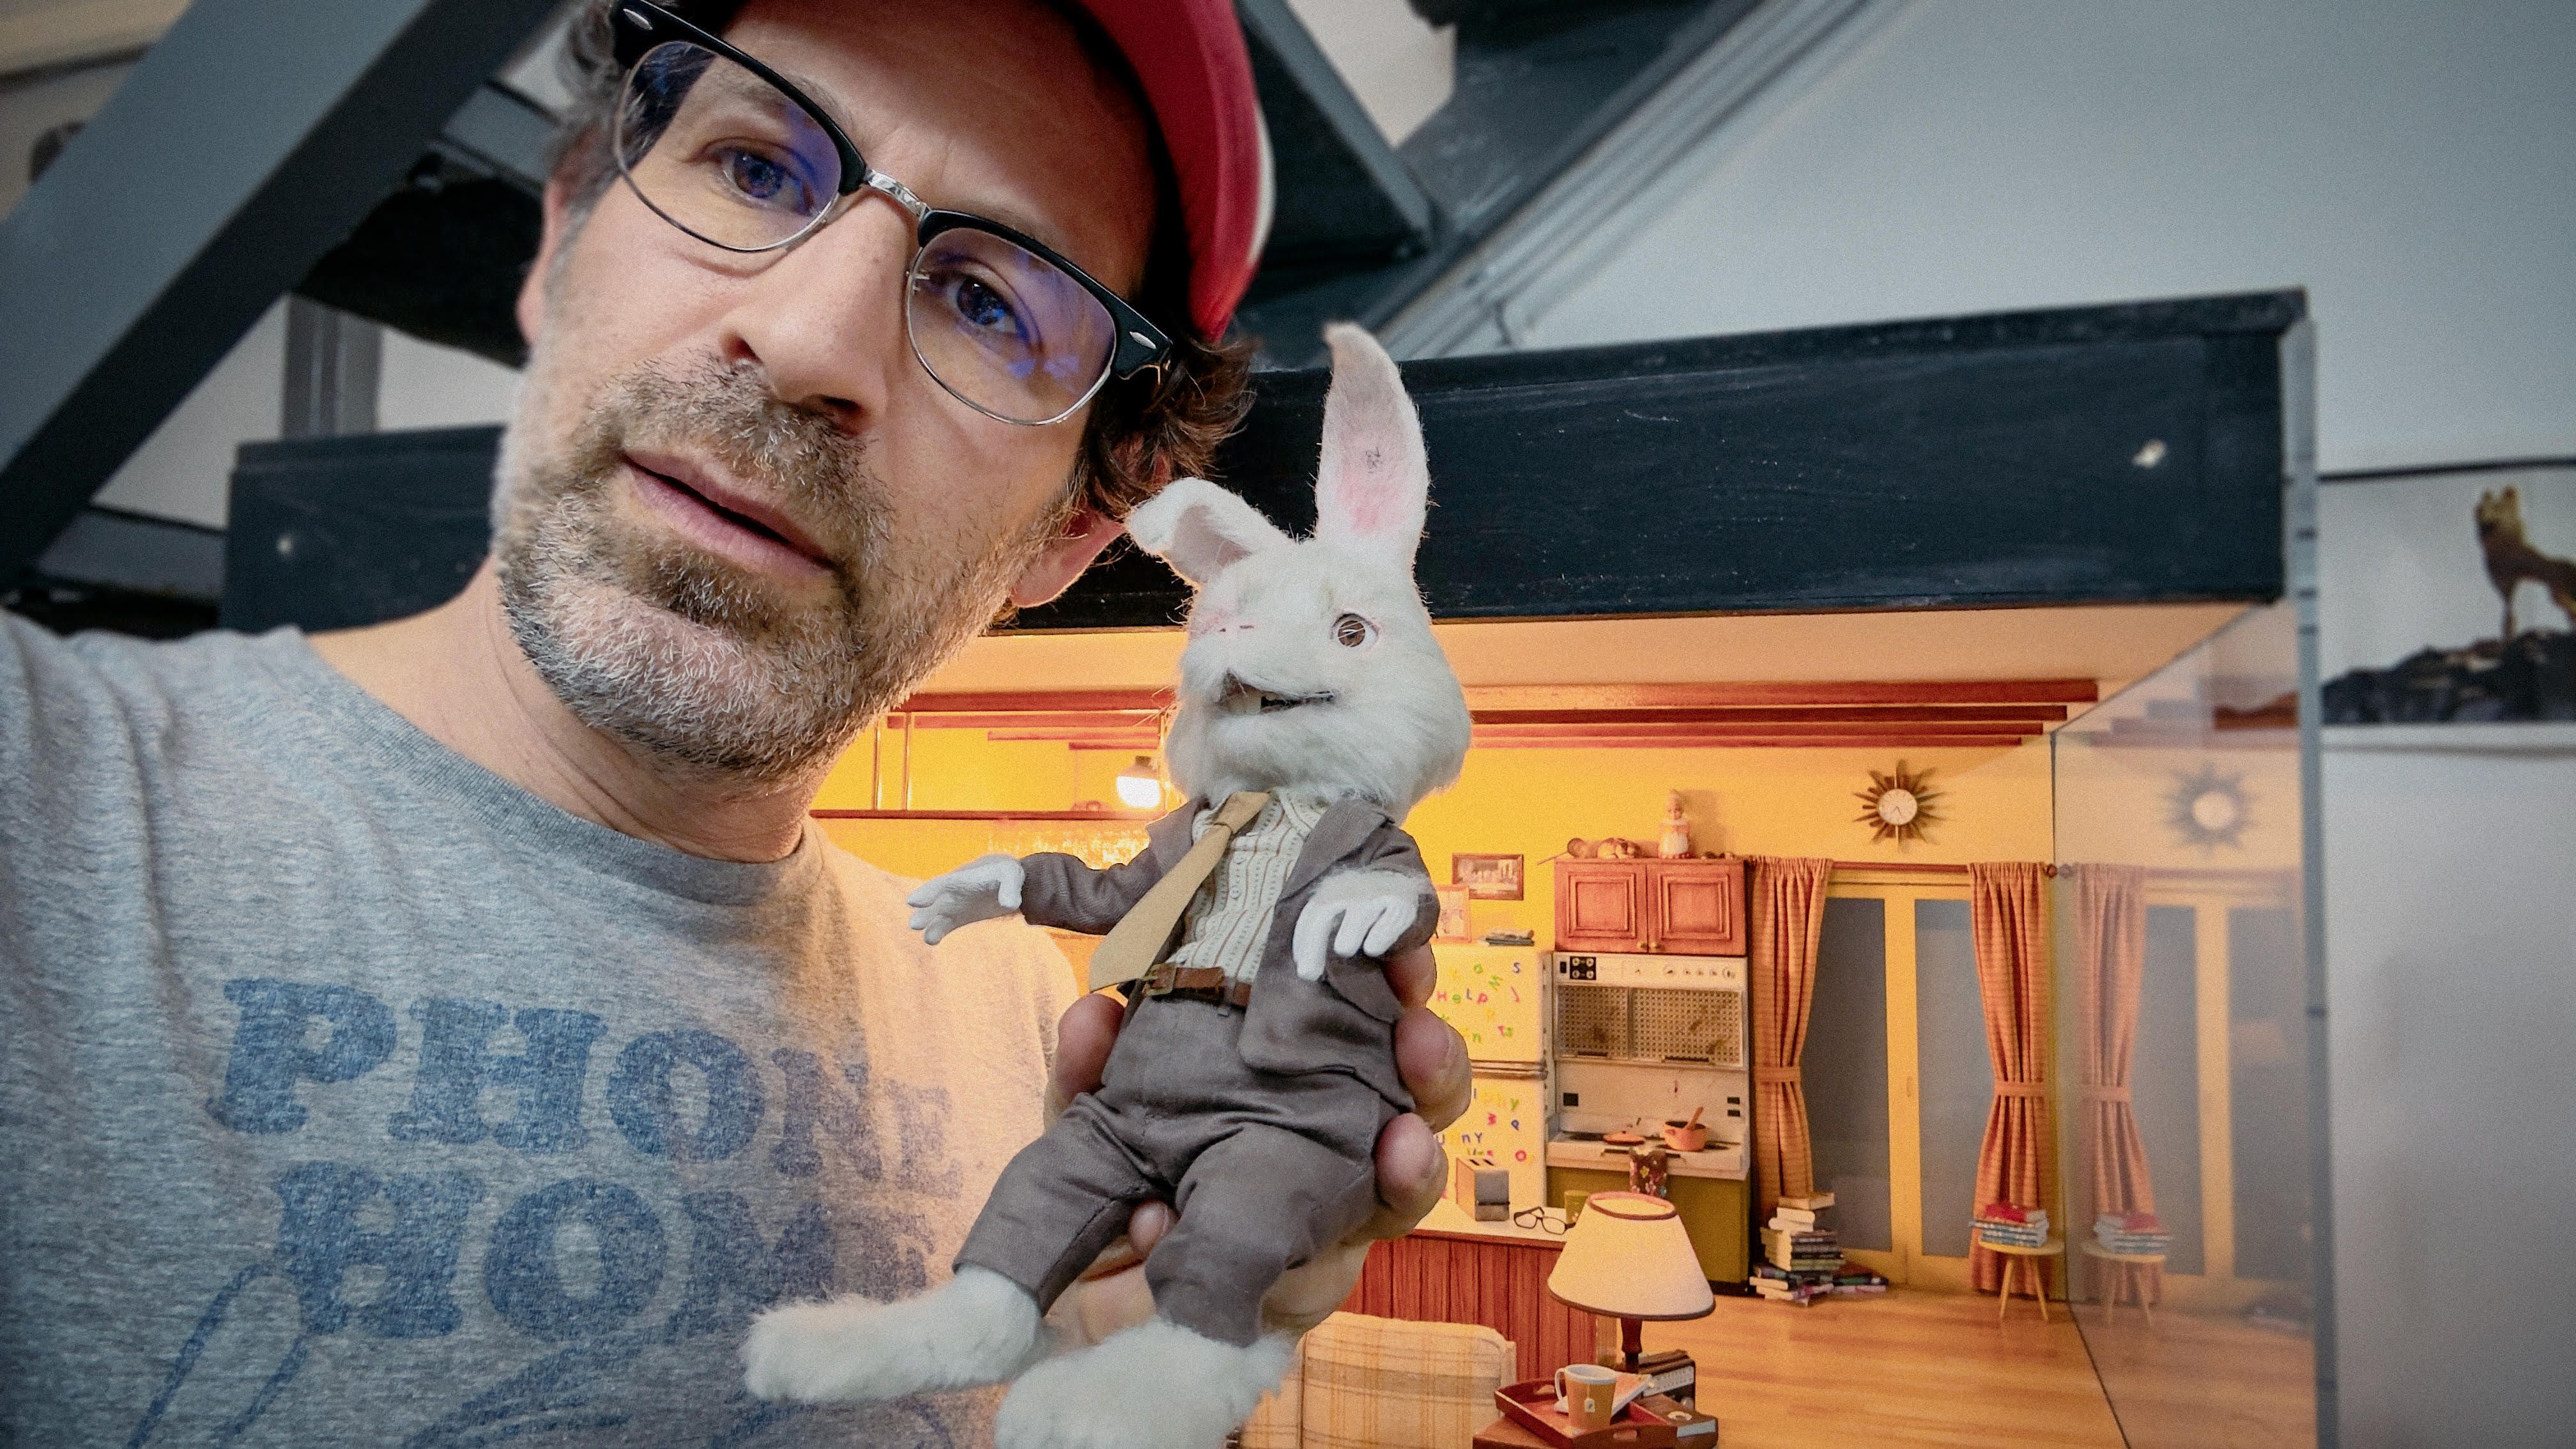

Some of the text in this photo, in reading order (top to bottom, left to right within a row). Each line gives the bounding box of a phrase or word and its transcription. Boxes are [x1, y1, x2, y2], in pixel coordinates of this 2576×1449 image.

[1513, 962, 1521, 974] S
[206, 977, 961, 1200] PHONE
[273, 1161, 936, 1344] HOME
